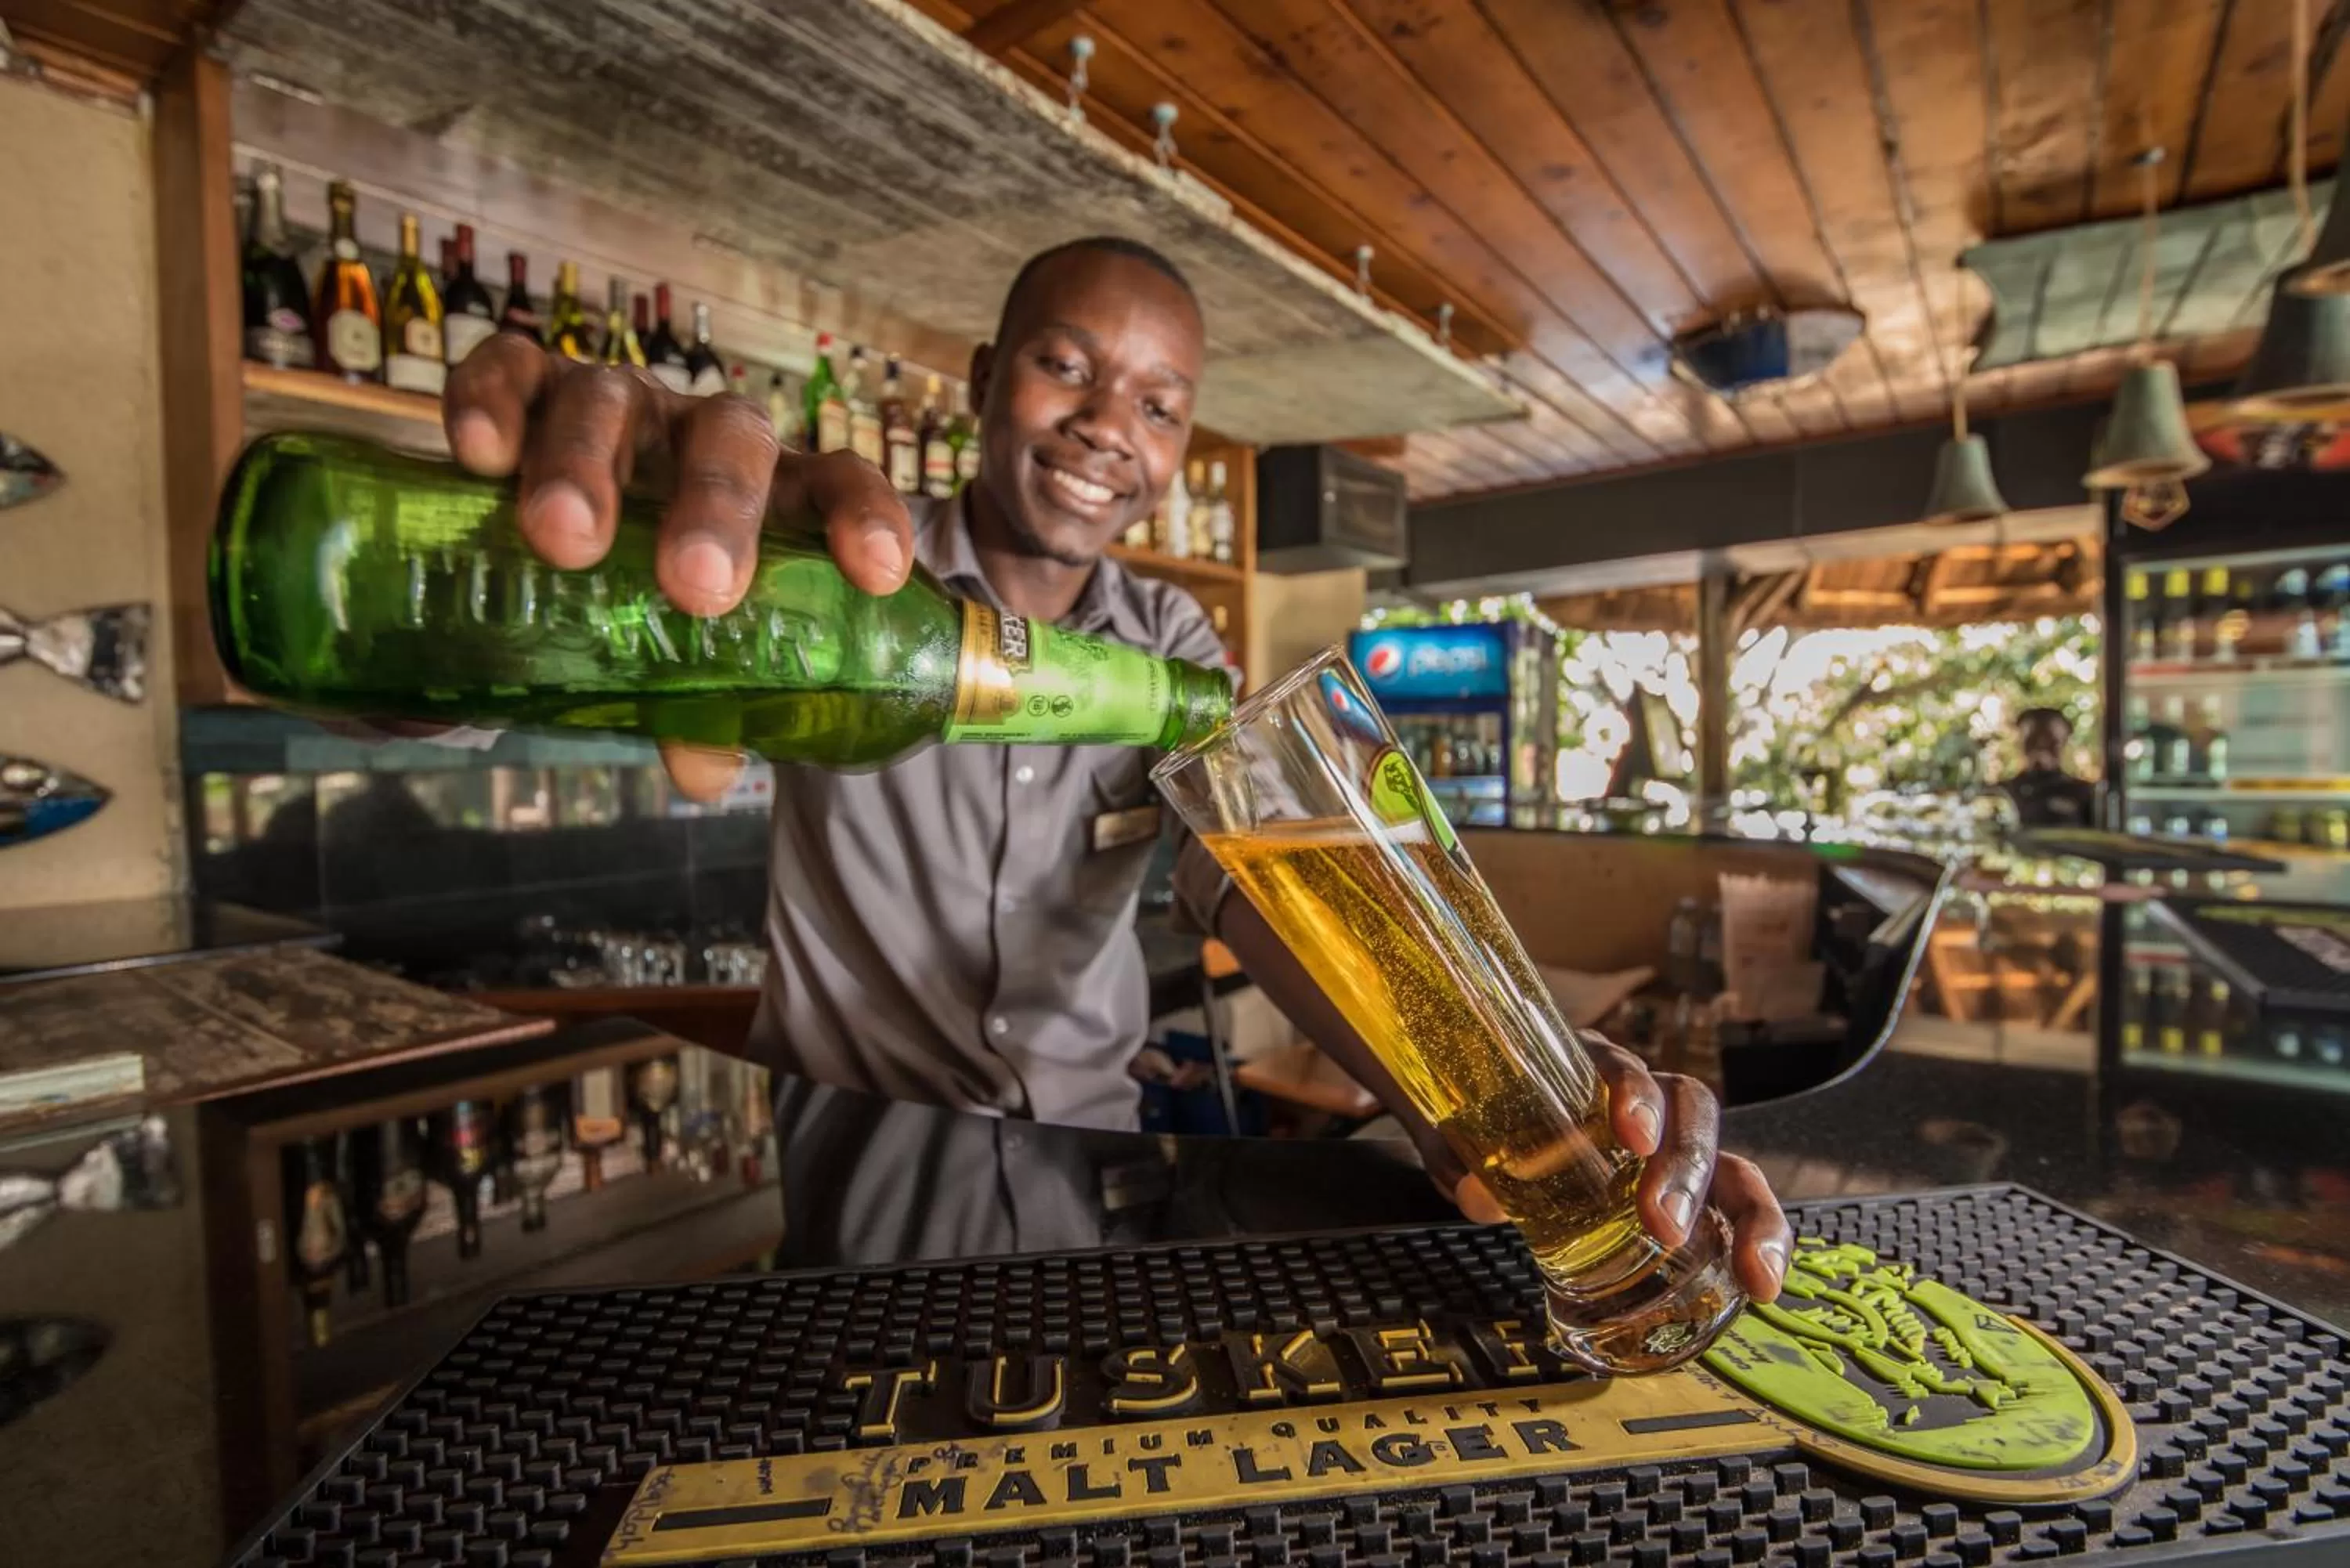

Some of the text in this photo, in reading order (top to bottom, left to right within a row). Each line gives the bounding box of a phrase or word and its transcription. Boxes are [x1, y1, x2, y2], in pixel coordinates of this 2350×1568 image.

[895, 1452, 1182, 1520] MALT
[1230, 1418, 1583, 1485] LAGER
[907, 1396, 1541, 1474] PREMIUM QUALITY
